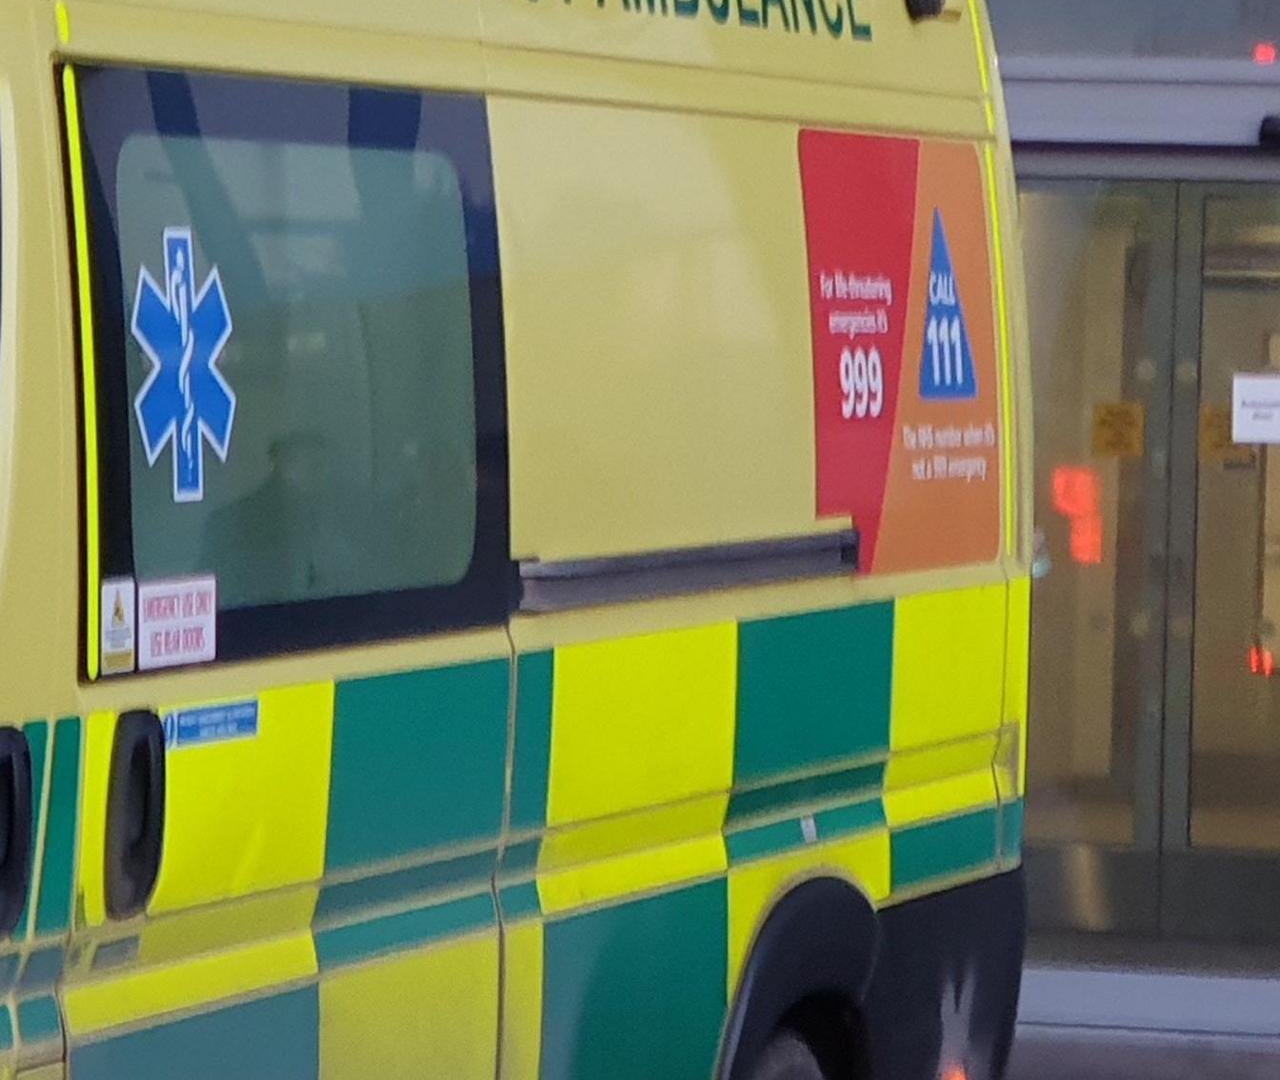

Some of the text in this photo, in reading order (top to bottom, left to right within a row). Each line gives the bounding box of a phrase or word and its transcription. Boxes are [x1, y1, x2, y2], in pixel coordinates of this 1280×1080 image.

[929, 271, 955, 306] CALL
[839, 347, 884, 419] 999
[926, 316, 963, 387] 111
